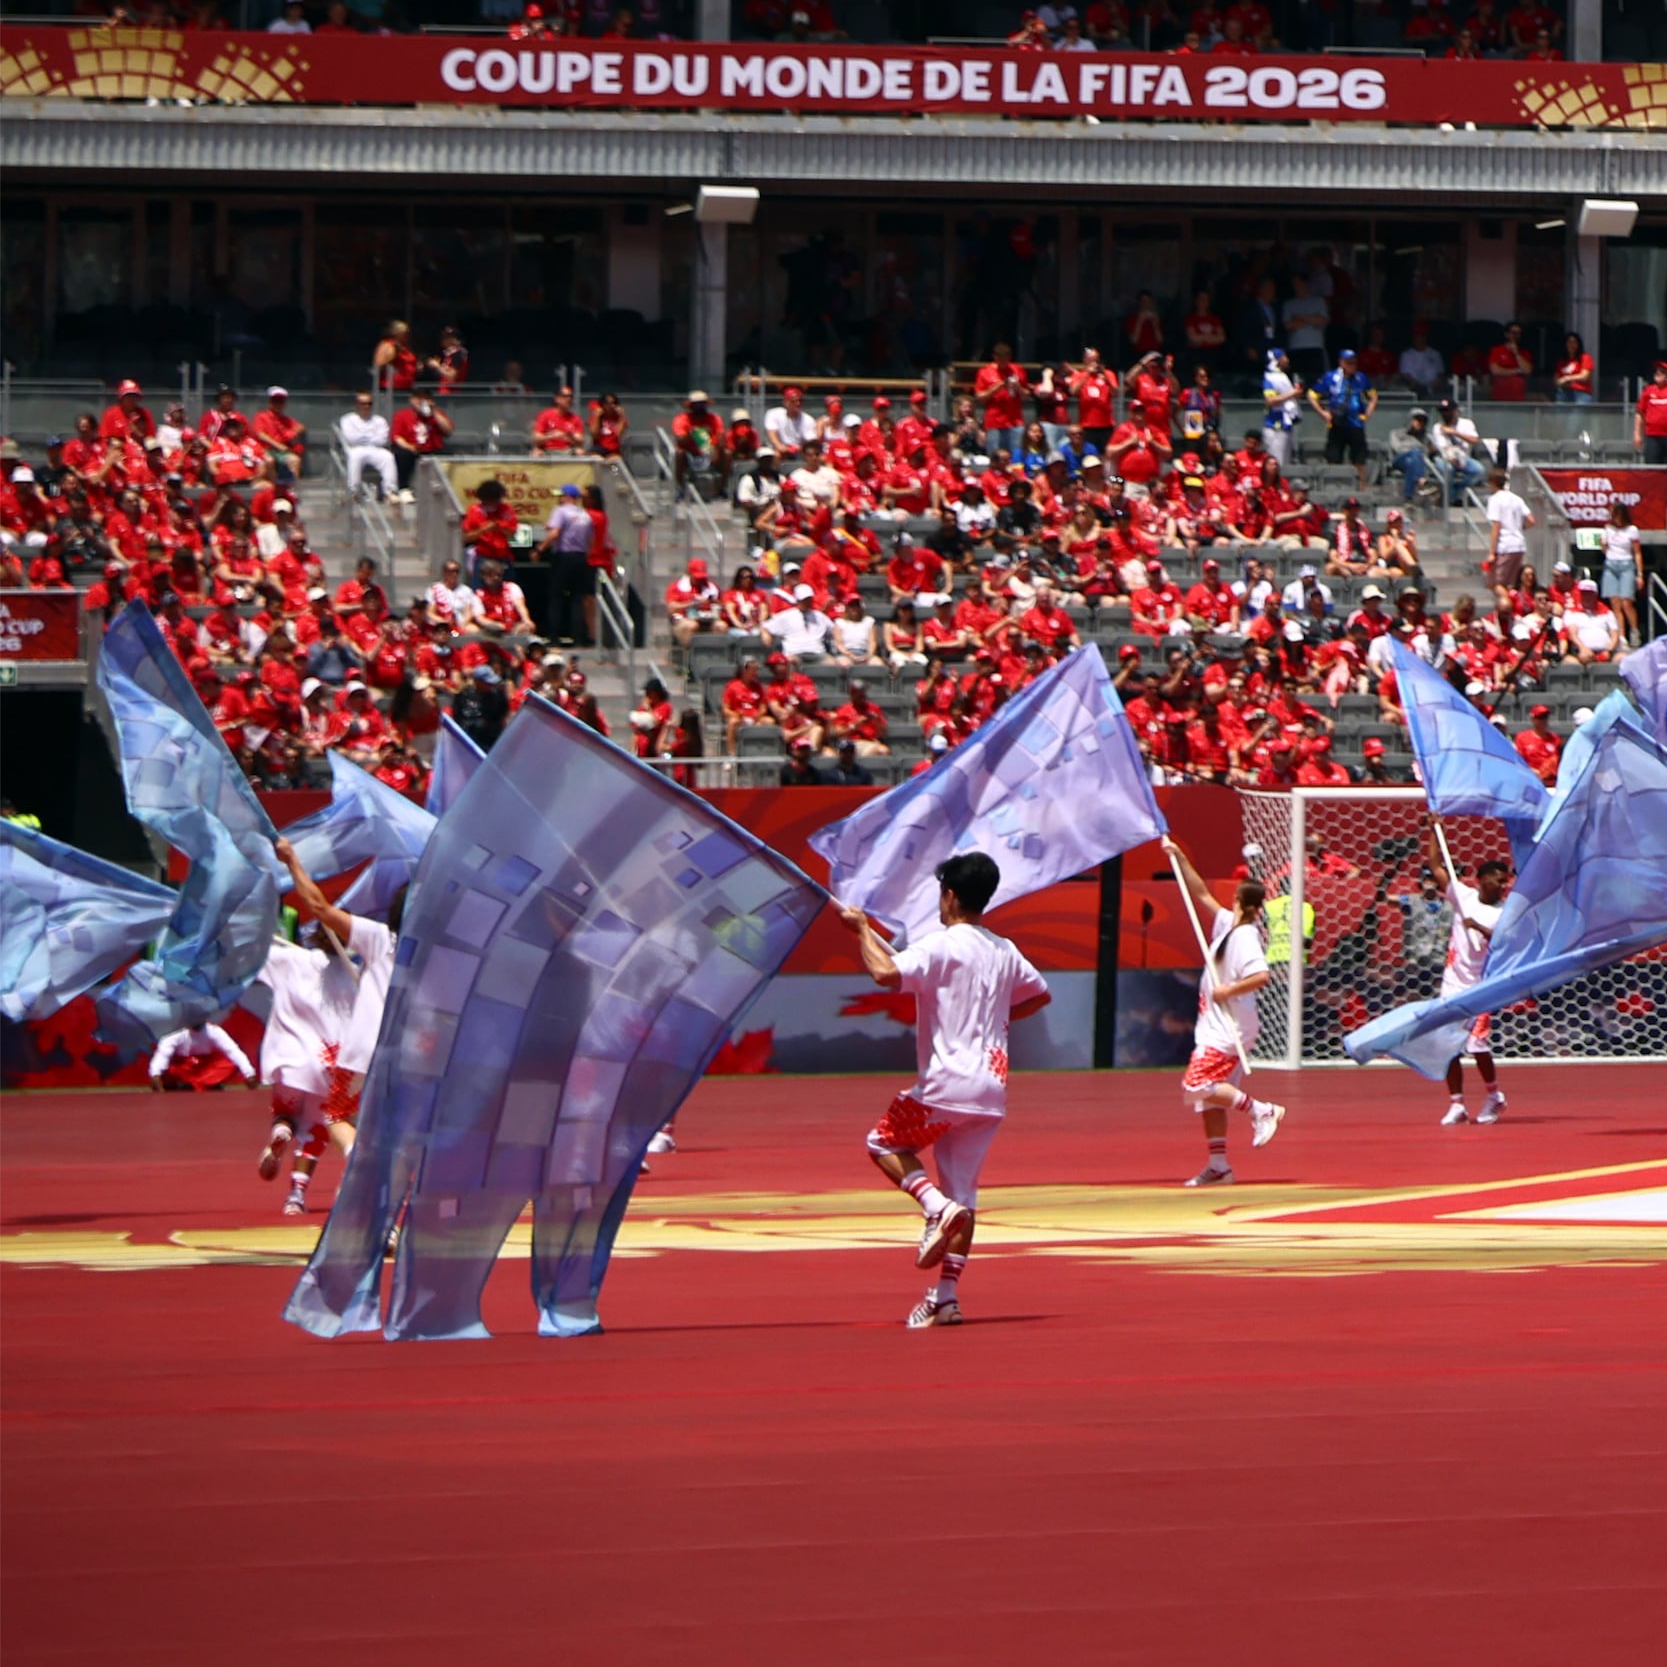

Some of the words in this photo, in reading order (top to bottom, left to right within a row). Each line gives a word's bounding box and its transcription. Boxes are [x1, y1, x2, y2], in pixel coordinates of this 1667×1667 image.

[441, 49, 623, 94] COUPE
[634, 55, 709, 96] DU
[722, 57, 913, 100] MONDE
[924, 61, 992, 101] DE
[1003, 62, 1069, 103] LA
[1080, 65, 1192, 106] FIFA
[1205, 67, 1386, 110] 2026
[1578, 477, 1613, 491] FIFA
[1568, 507, 1611, 521] 202
[7, 618, 45, 635] CUP
